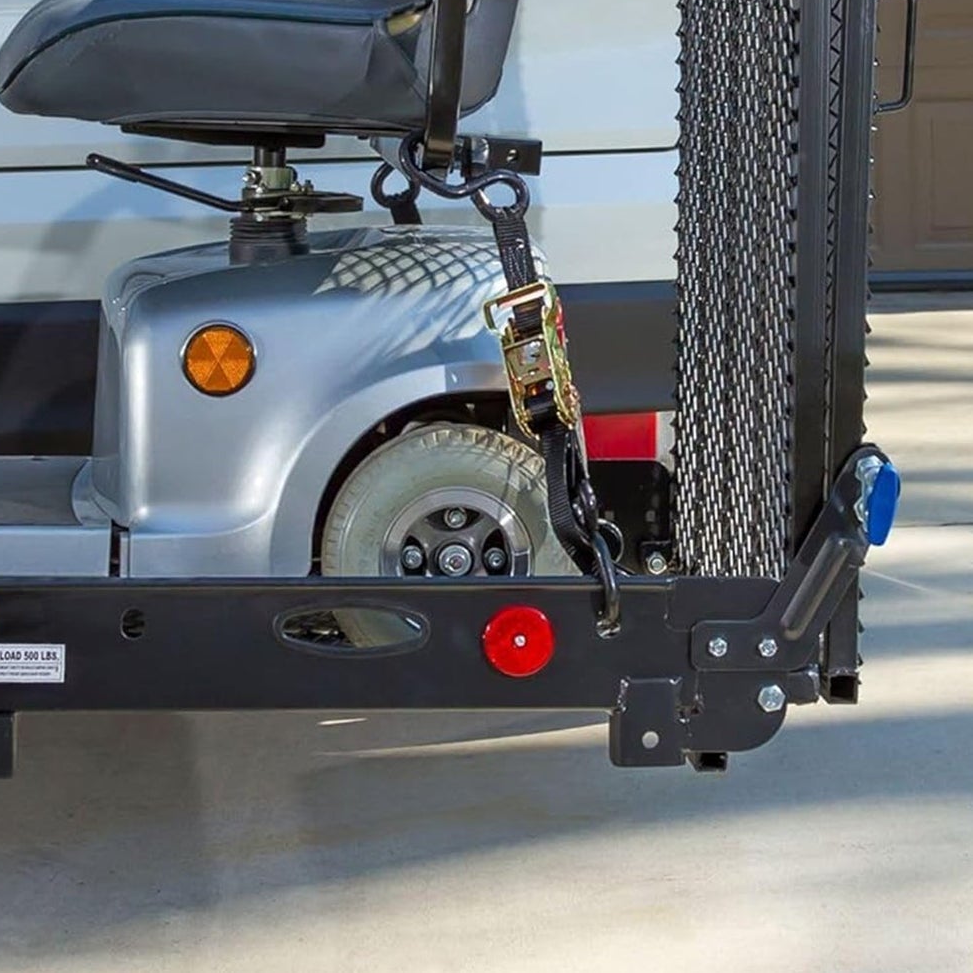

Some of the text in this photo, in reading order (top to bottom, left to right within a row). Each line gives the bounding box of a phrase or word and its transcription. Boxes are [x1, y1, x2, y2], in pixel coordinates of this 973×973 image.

[0, 651, 21, 661] LOAD
[24, 651, 38, 661] 500
[40, 651, 60, 662] LBS.
